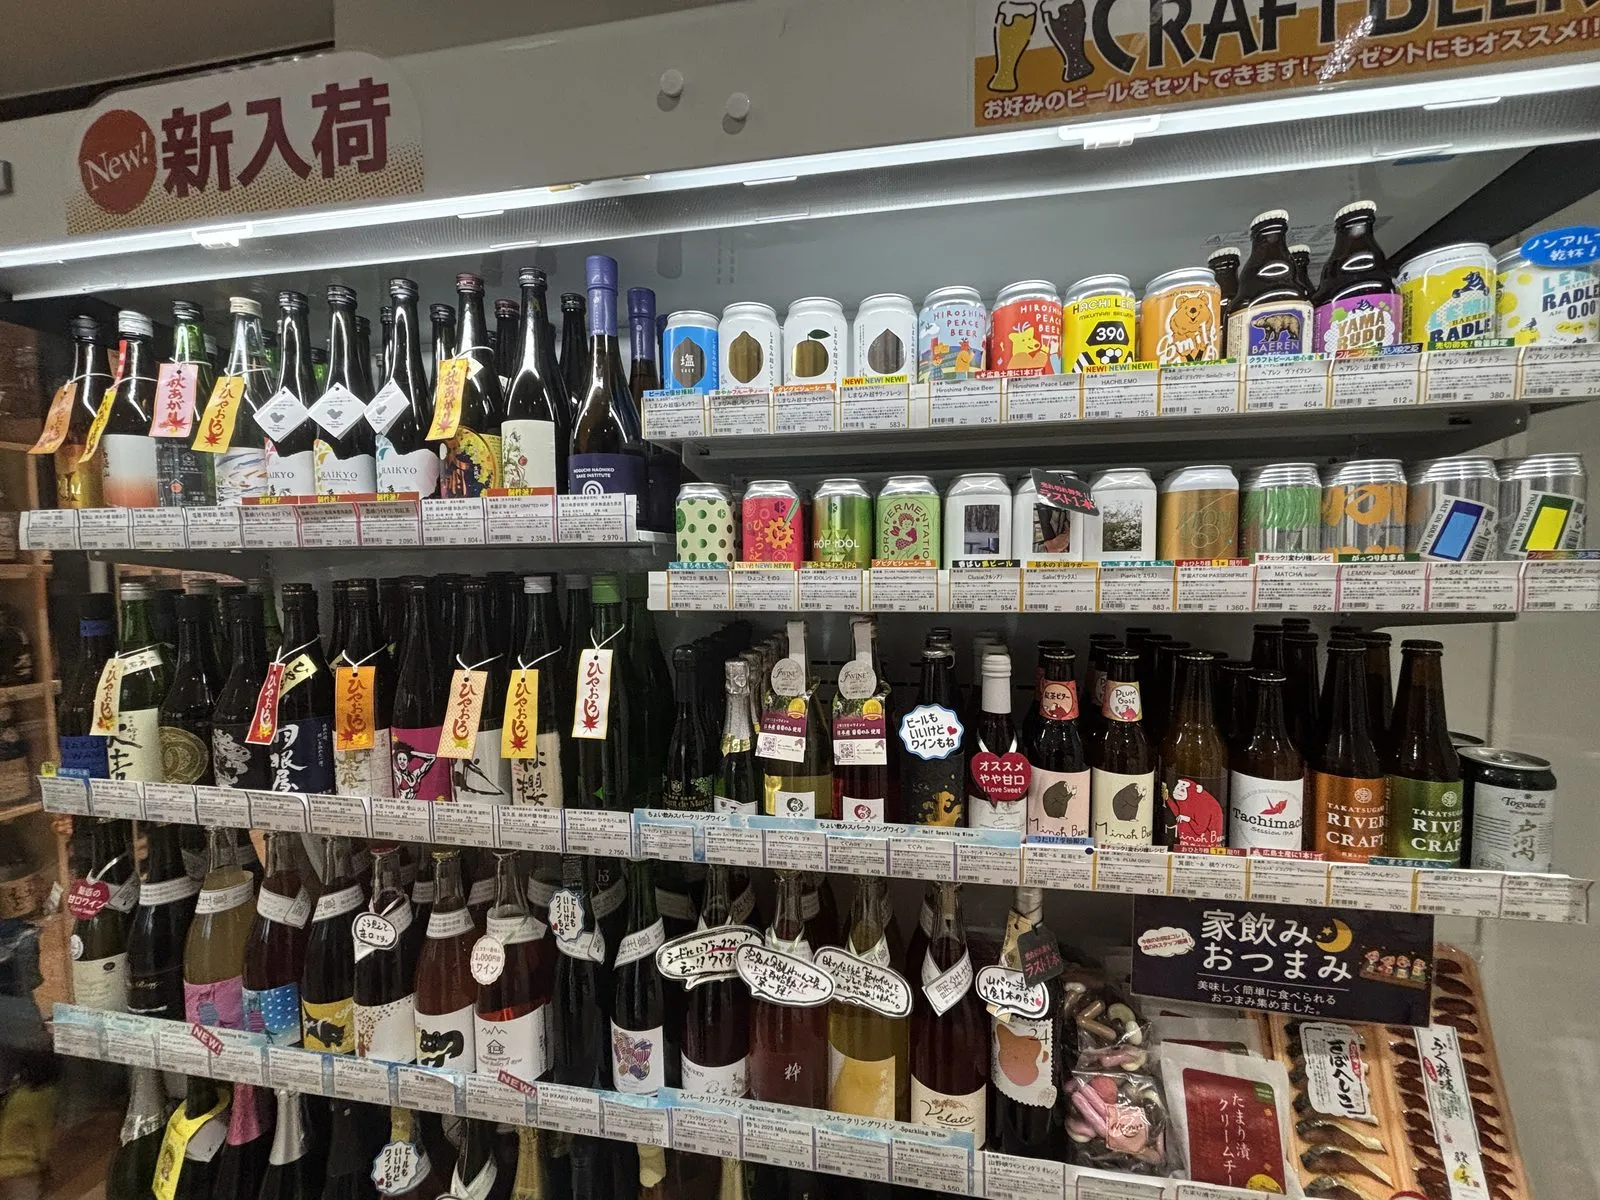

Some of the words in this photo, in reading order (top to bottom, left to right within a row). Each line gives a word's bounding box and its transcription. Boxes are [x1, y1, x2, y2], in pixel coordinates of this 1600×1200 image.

[160, 77, 391, 199] 新入荷
[84, 131, 156, 194] New!
[1528, 232, 1600, 251] ノンアル
[1073, 298, 1111, 315] HACHI
[1542, 285, 1600, 313] RADLE
[1567, 300, 1596, 321] 0.00
[947, 319, 979, 328] PEACE
[1338, 310, 1385, 334] YAMA
[1430, 317, 1491, 342] RADLE
[950, 329, 978, 337] BEER
[1096, 327, 1125, 341] 390
[1252, 341, 1300, 354] BAEREN
[680, 353, 695, 368] 塩
[208, 383, 235, 438] ひやおろし
[269, 471, 295, 480] AIKYO
[321, 471, 358, 480] RAIKYO
[381, 466, 418, 476] RAIKYO
[813, 538, 830, 549] HOP
[958, 560, 1013, 568] 香ばし黒ビール
[1274, 570, 1303, 578] MATCHA
[1312, 603, 1328, 611] 922
[99, 668, 119, 722] ひやおろし
[258, 672, 277, 727] ひやおろし
[583, 661, 604, 721] ひやおろし
[1115, 689, 1137, 698] PLUM
[345, 679, 368, 732] ひやおろし
[451, 681, 477, 741] ひやおろし
[510, 681, 533, 741] ひやおろし
[906, 711, 940, 729] ビールも
[870, 727, 881, 737] 使用
[909, 723, 945, 741] いいけど
[911, 735, 956, 751] ワインもね
[979, 760, 1024, 773] オススメ
[979, 773, 1026, 787] やや甘口
[986, 786, 999, 795] Love
[1000, 786, 1023, 795] Sweet
[1327, 802, 1385, 814] TAKATSUGA
[1500, 795, 1546, 810] Togouchi
[647, 811, 727, 823] ちょい飲みスパークリングワイン
[1233, 808, 1304, 833] Tachimac
[1326, 811, 1384, 830] RIVER
[1412, 817, 1462, 834] RIVE
[819, 822, 907, 836] ちょい飲みスパークリングワイン
[1028, 817, 1066, 838] Minoh
[1095, 822, 1137, 841] Minoh
[1165, 825, 1208, 843] Minoh
[1411, 837, 1462, 853] CRAF
[1513, 821, 1536, 862] 戸河内
[1263, 850, 1314, 860] 広島土産に1本!
[68, 893, 106, 908] 甘口ワイン
[554, 895, 566, 941] ワインもね
[562, 896, 571, 932] いいけど
[569, 895, 578, 928] ビールも
[1201, 907, 1315, 947] 家飲み
[476, 962, 499, 975] ワイン
[1203, 941, 1353, 984] おつまみ
[1198, 979, 1337, 1006] 美味しく簡単に食べられる
[1211, 993, 1323, 1016] おつまみ集めました。
[193, 1025, 224, 1055] NEW!
[1030, 1028, 1050, 1045] 24
[500, 1073, 537, 1097] NEW!
[680, 1092, 744, 1109] スパークリングワイン
[825, 1114, 896, 1131] スパークリングワイン
[1232, 1091, 1254, 1160] たまり漬
[384, 1147, 394, 1189] ワインもね
[394, 1148, 403, 1182] いいけど
[403, 1146, 412, 1178] ビールも
